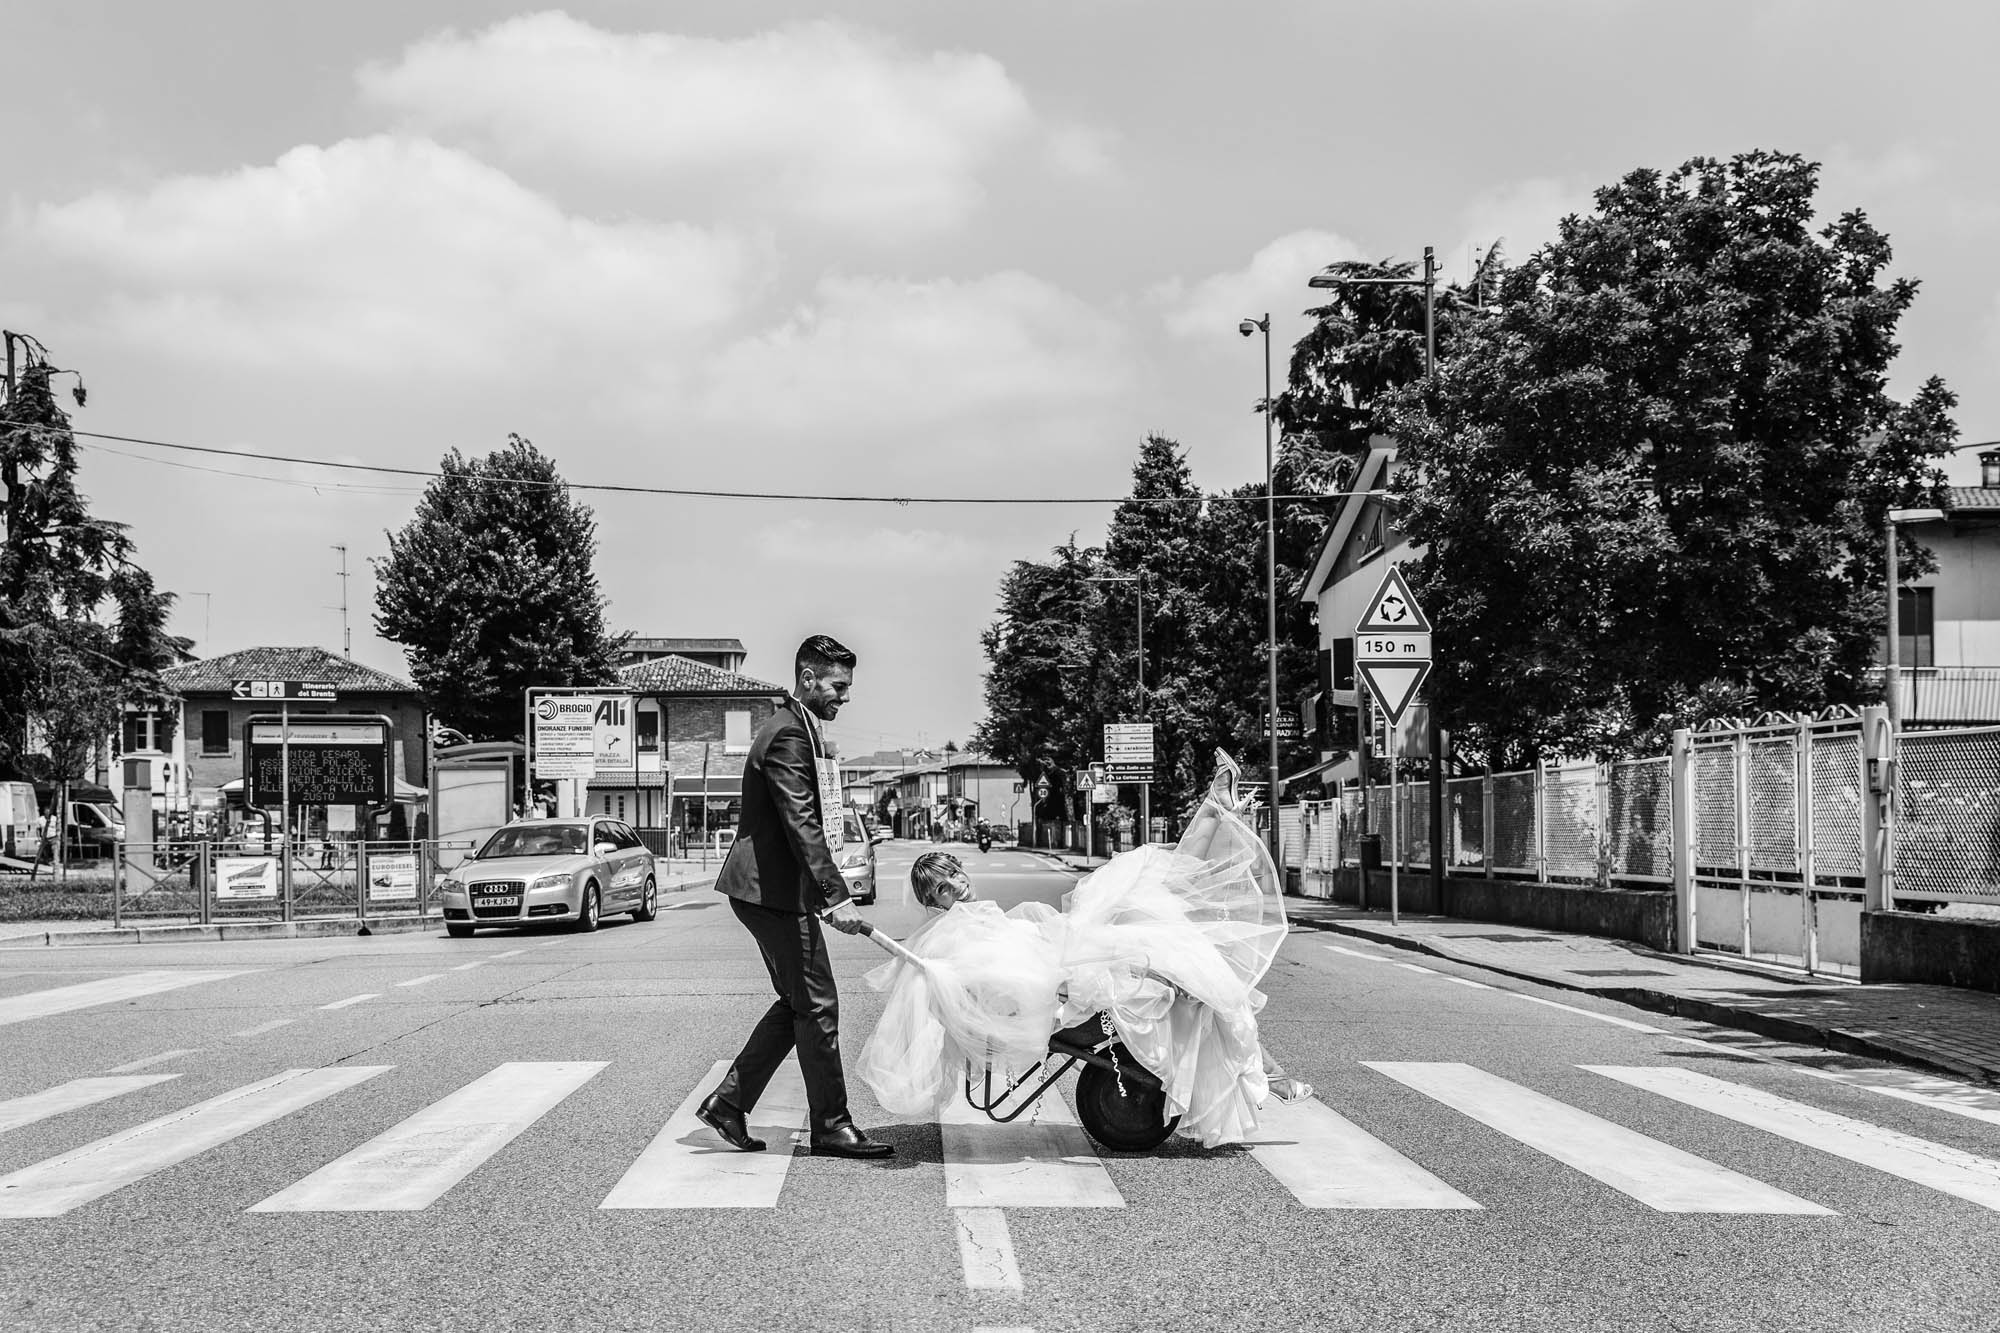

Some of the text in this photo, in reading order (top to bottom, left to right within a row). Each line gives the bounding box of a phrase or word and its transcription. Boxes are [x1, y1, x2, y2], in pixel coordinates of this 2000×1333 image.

[1365, 640, 1416, 653] 150 m
[302, 682, 336, 690] Itinerario
[559, 704, 592, 713] BROGIO
[321, 750, 360, 759] CESARO
[329, 767, 369, 776] RICEVE
[261, 776, 272, 784] IL
[323, 776, 353, 784] DALLE
[362, 776, 375, 784] 15
[292, 784, 323, 793] 17.30
[329, 784, 336, 793] A
[342, 784, 375, 793] VILLA
[303, 792, 335, 801] ZUSTO
[481, 897, 515, 905] 49-KJR-7
